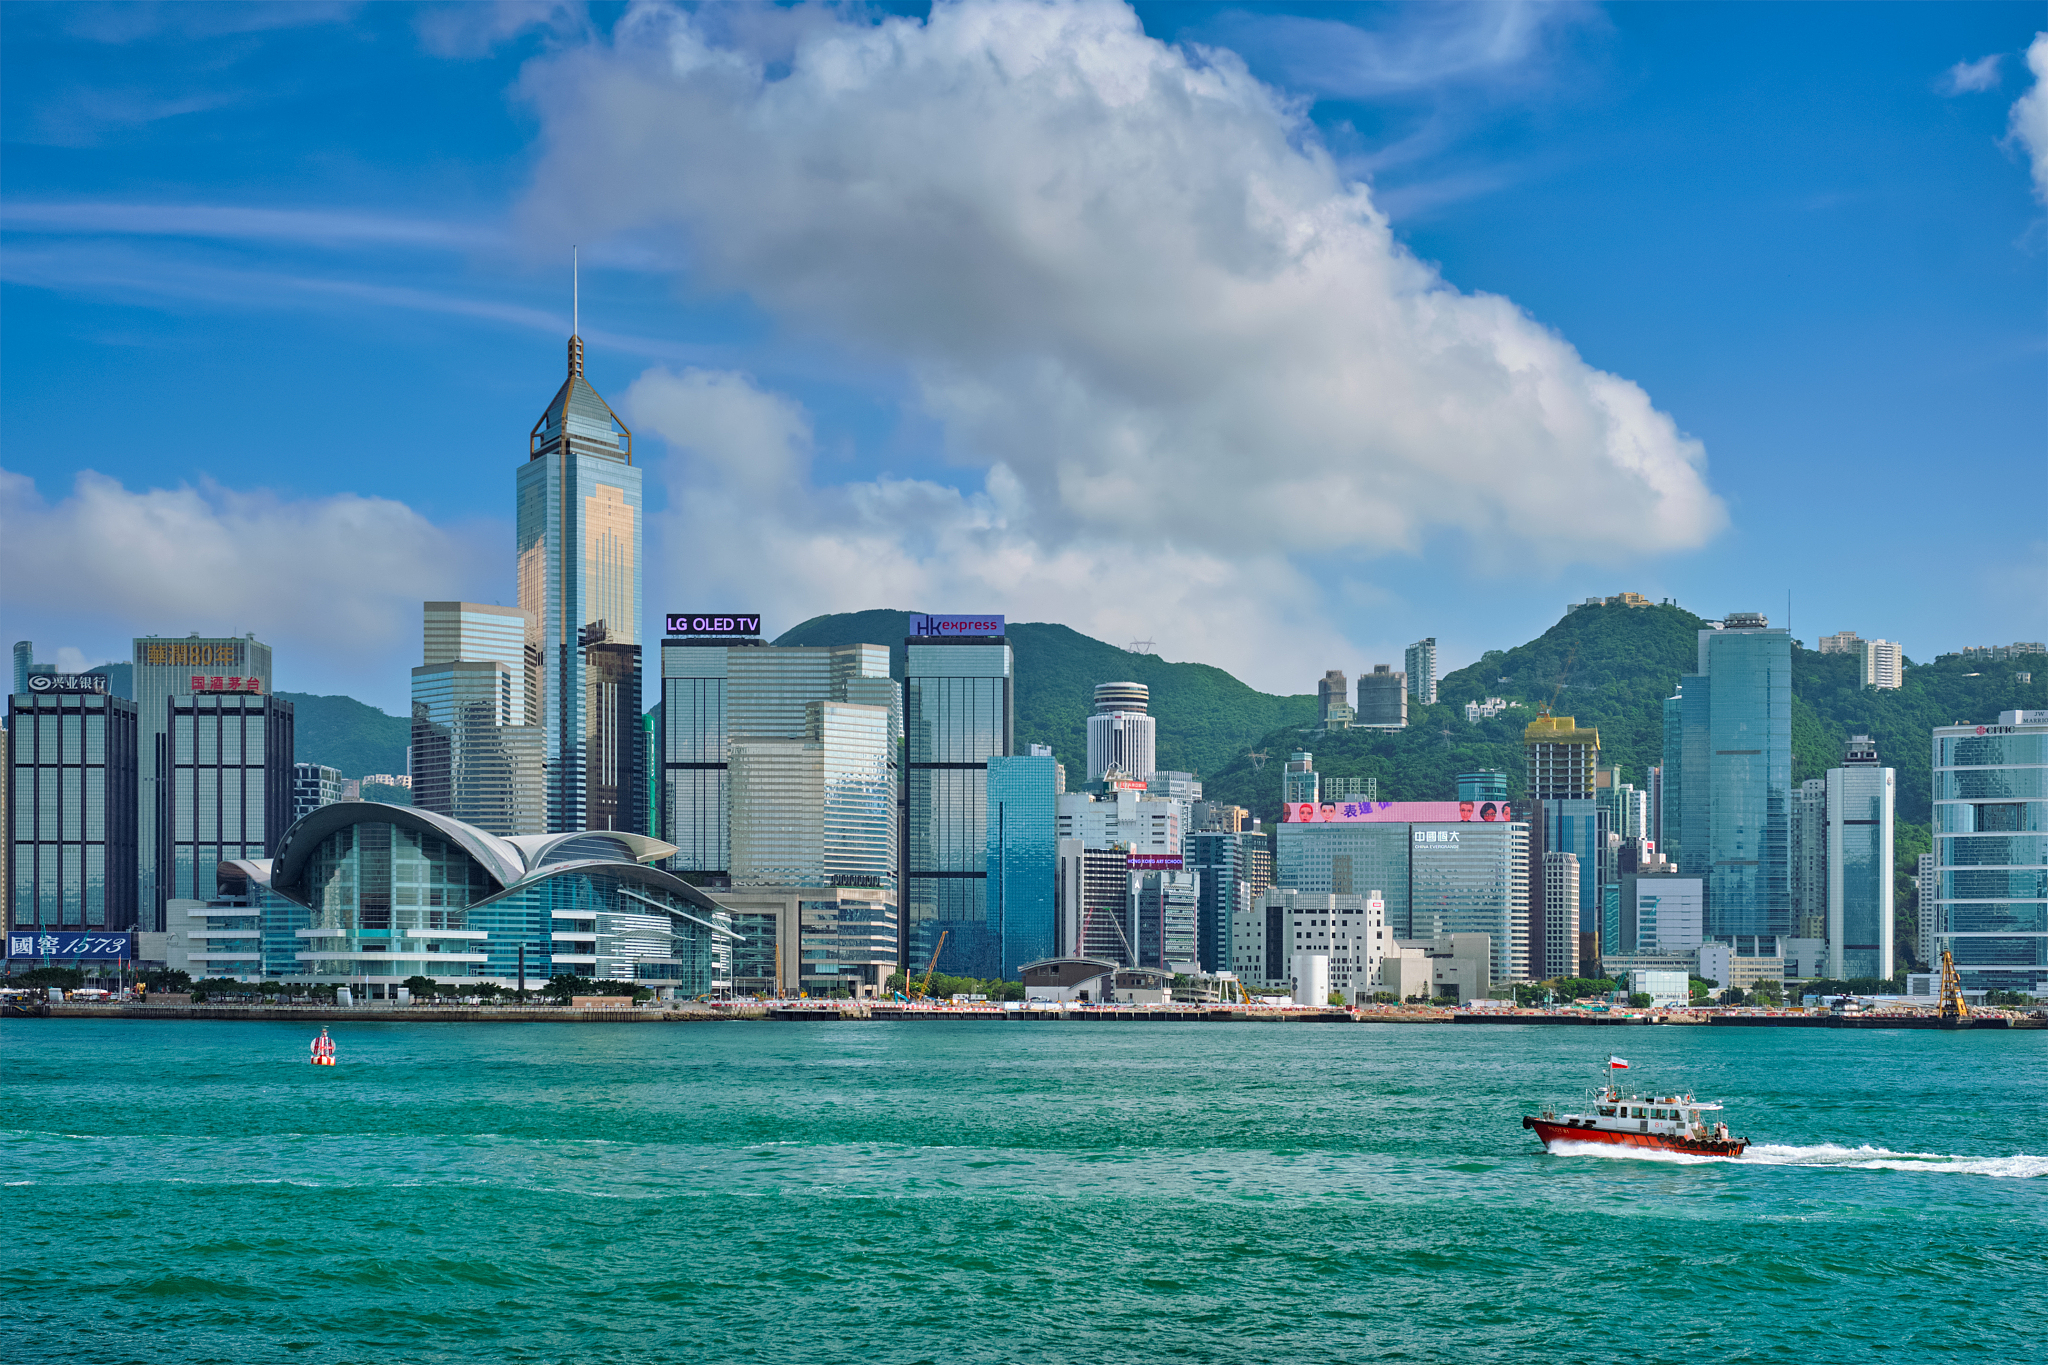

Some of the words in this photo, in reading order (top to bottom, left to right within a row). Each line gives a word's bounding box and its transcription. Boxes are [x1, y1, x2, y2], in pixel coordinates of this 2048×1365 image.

[667, 617, 688, 631] LG
[692, 617, 735, 631] OLED
[736, 617, 759, 631] TV
[942, 621, 998, 633] express
[148, 644, 235, 666] 華潤80年
[51, 675, 106, 690] 兴业银行
[191, 675, 260, 691] 国酒茅台
[1986, 725, 2016, 735] CITIC
